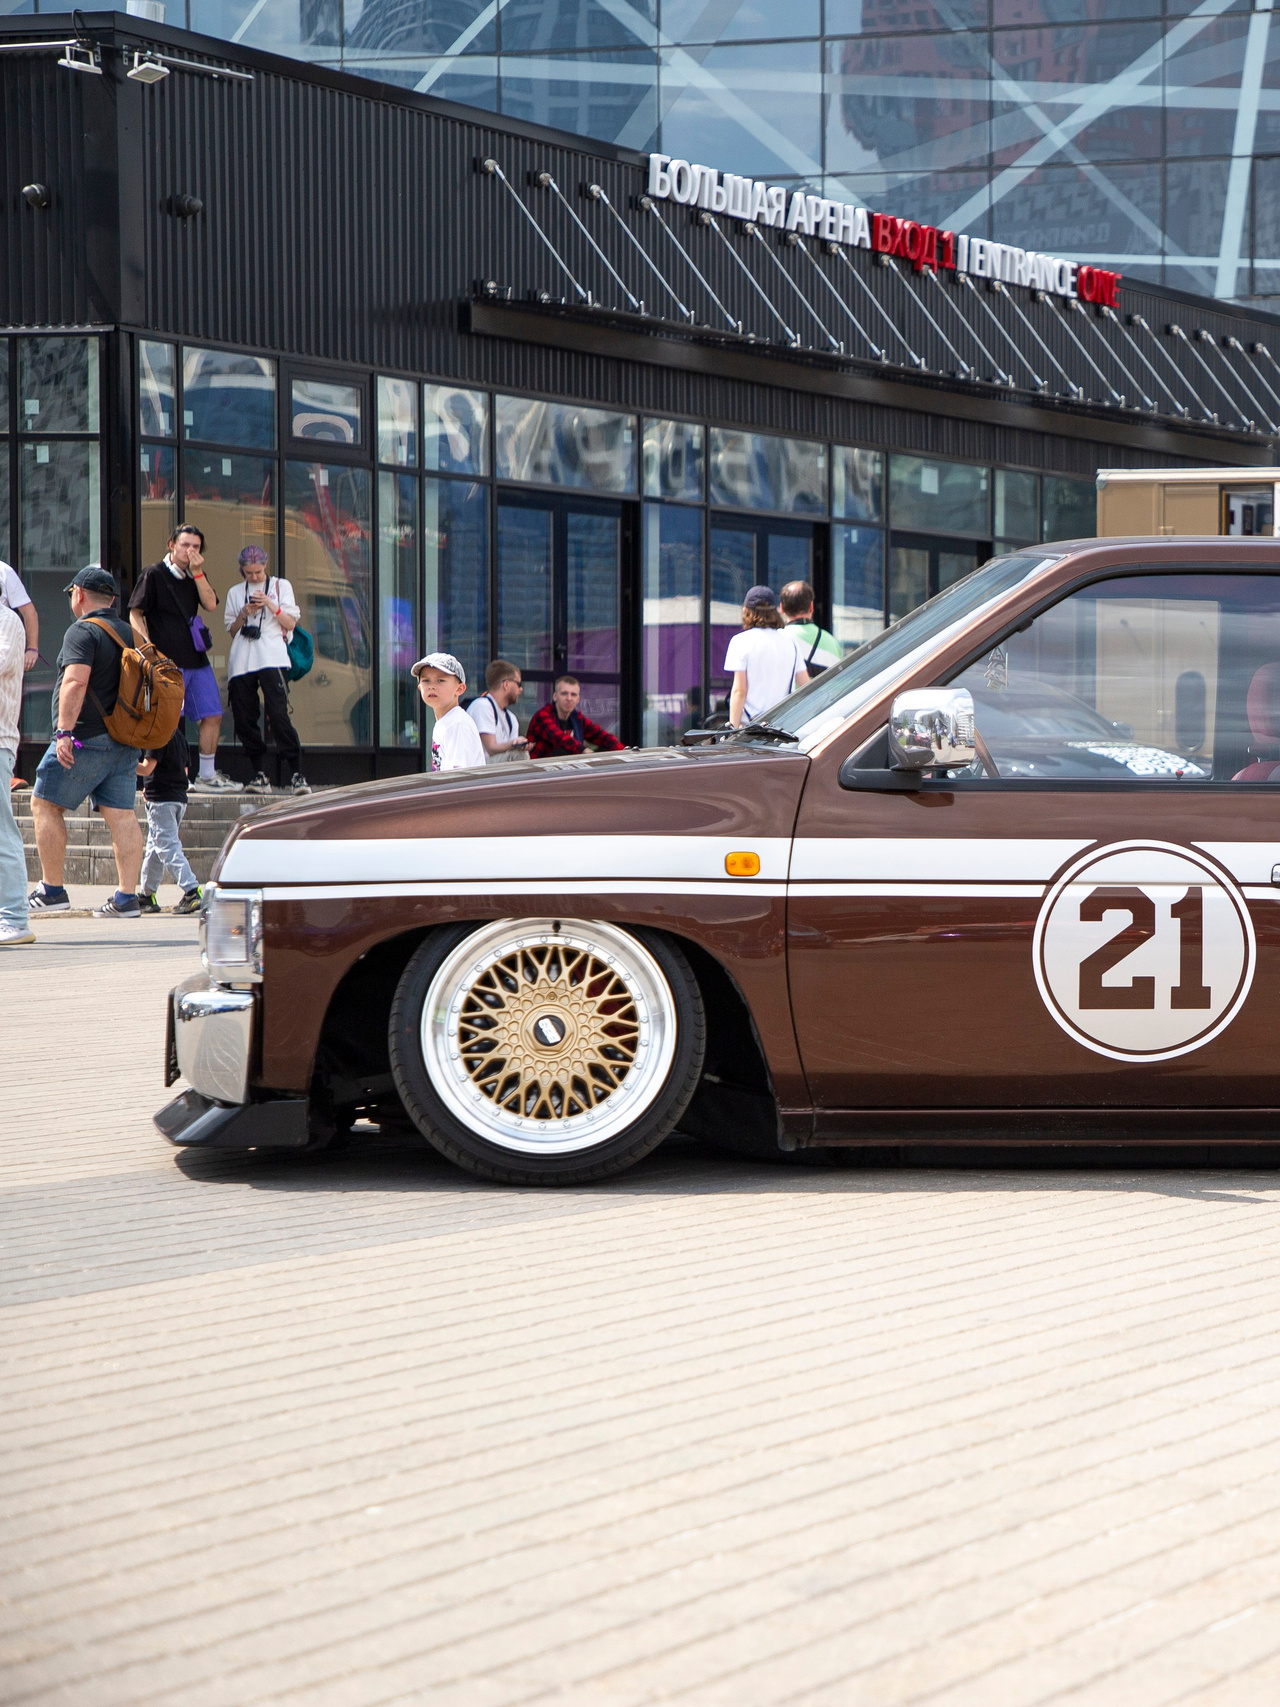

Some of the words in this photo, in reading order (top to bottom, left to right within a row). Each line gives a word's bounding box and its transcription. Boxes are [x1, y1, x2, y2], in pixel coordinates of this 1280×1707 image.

[648, 153, 787, 229] БОЛЬШАЯ
[785, 191, 872, 250] АРЕНА
[872, 212, 937, 274] ВХОД
[938, 230, 956, 270] 1
[969, 237, 1079, 299] ENTRANCE
[1079, 886, 1211, 1010] 21
